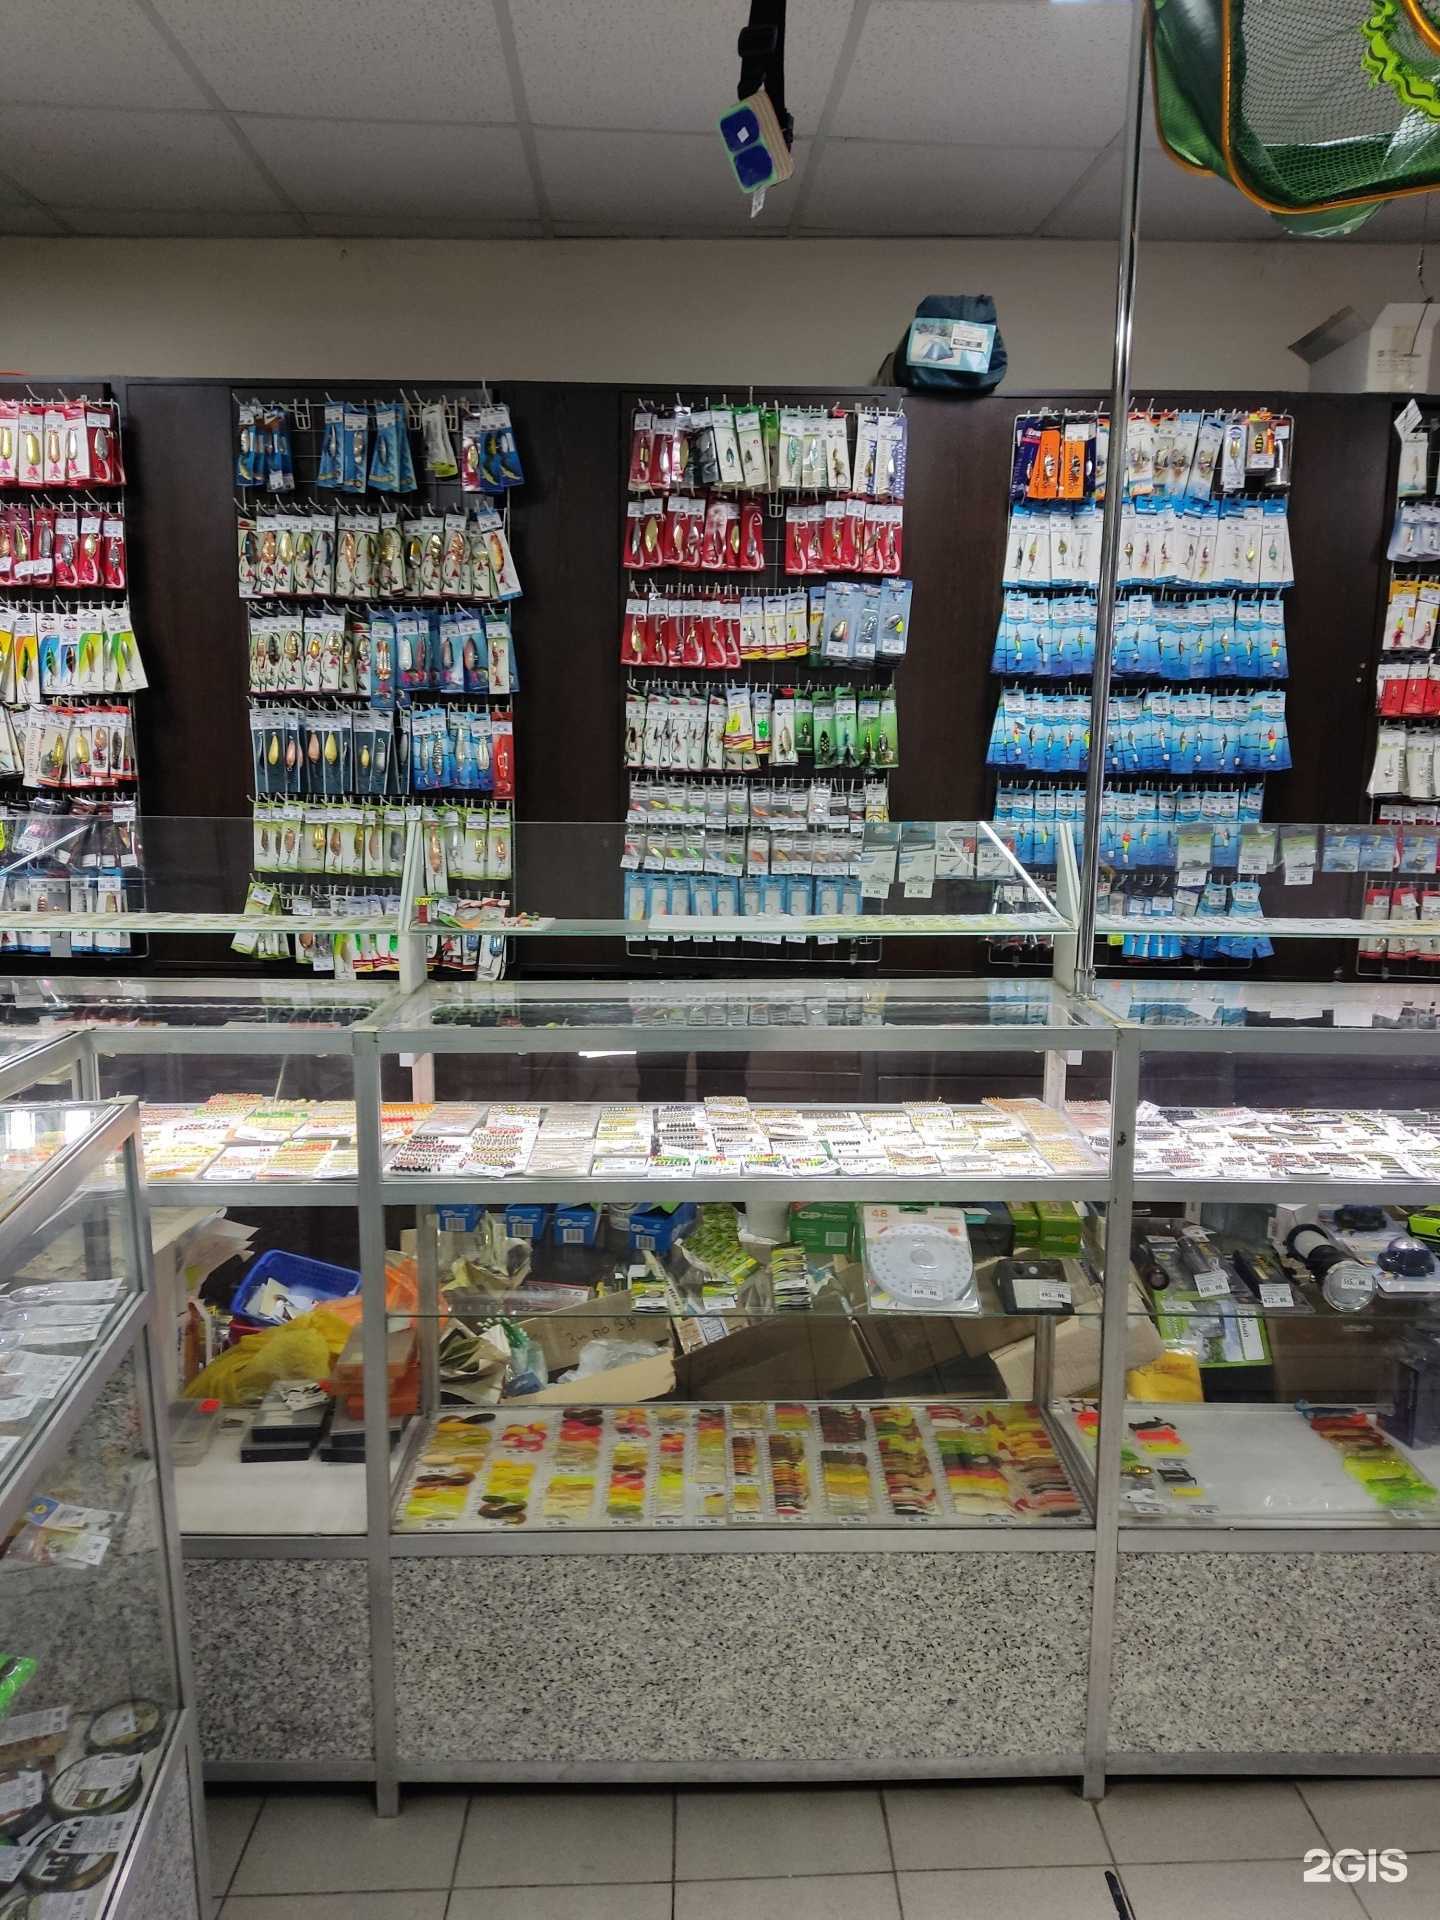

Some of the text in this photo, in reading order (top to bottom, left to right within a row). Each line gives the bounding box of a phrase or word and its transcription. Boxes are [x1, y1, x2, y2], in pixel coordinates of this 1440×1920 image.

[798, 1211, 822, 1219] GP
[871, 1209, 888, 1217] 48
[558, 1218, 573, 1227] GP
[630, 1223, 646, 1233] GP
